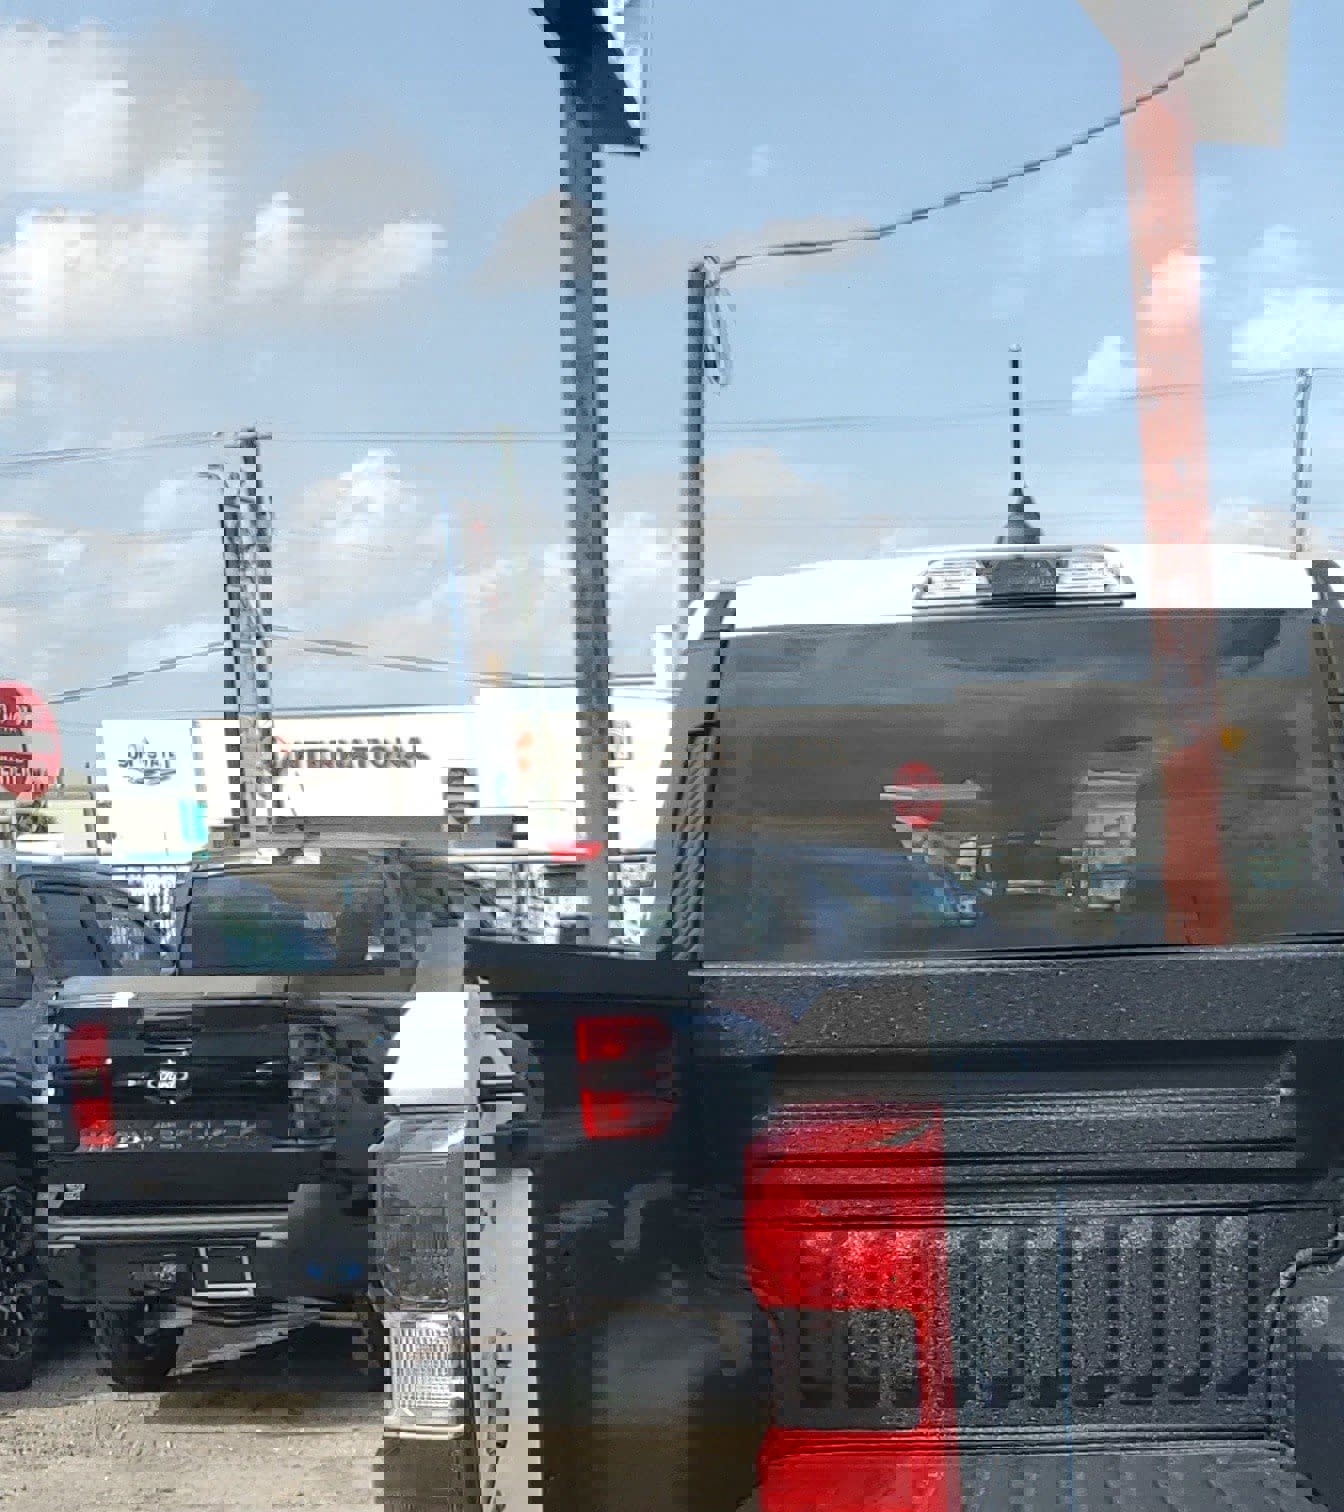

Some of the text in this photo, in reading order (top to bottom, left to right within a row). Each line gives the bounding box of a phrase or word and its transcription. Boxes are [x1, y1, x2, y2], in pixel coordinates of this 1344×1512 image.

[19, 703, 44, 727] NOT
[245, 747, 277, 760] SUN
[568, 736, 847, 767] INTERNATIONAL
[184, 1118, 515, 1146] MAVERICK
